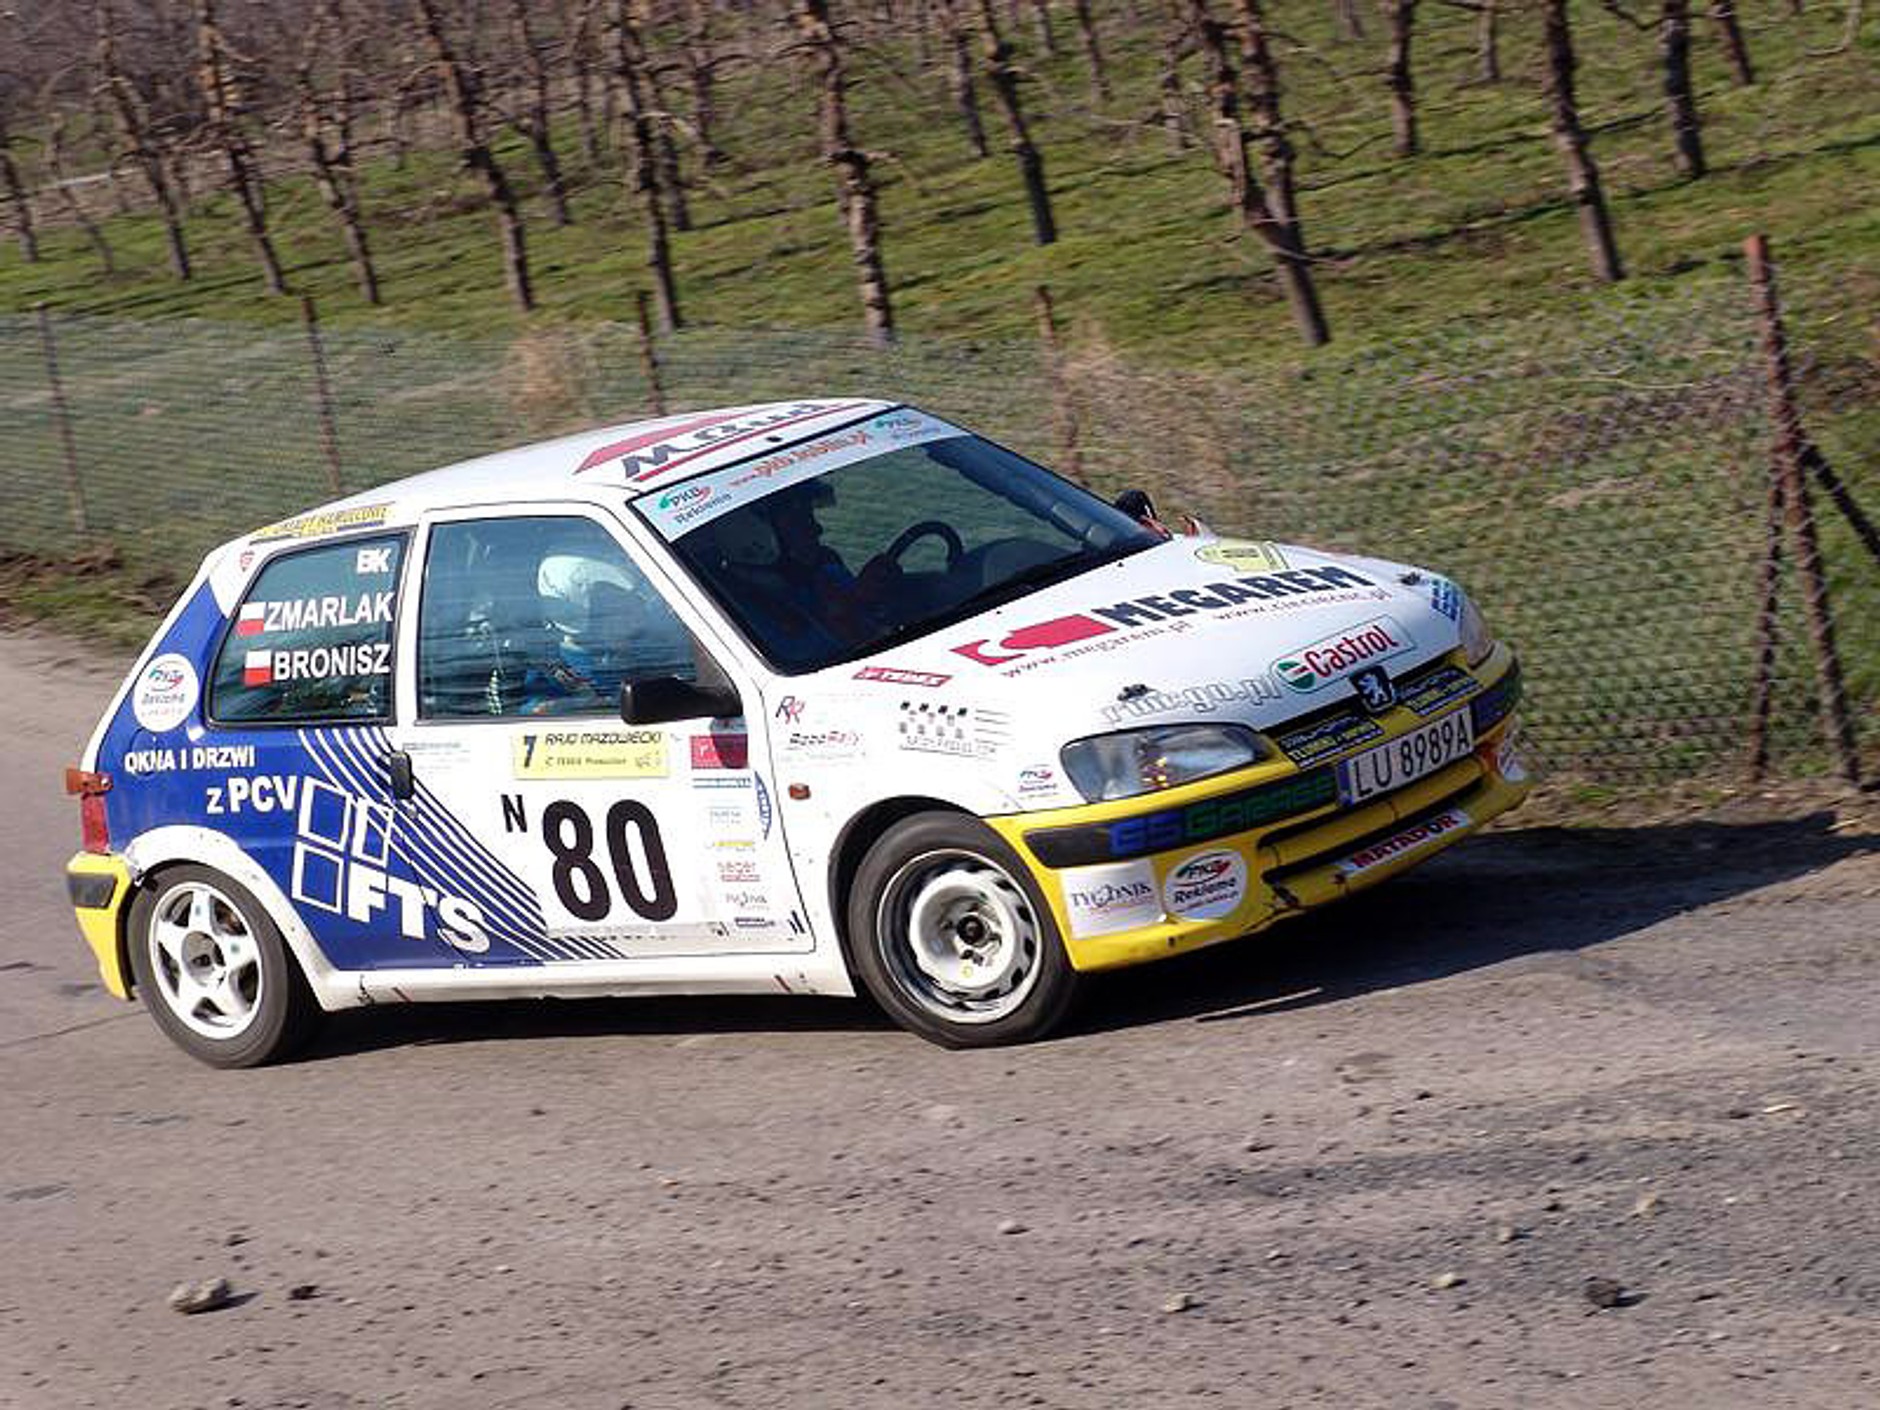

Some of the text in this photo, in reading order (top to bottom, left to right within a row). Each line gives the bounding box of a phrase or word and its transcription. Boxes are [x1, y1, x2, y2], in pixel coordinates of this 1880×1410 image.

[357, 549, 391, 573] BK
[264, 592, 395, 631] ZMARLAK
[1091, 565, 1377, 628] MEGAREM
[274, 644, 390, 680] BRONISZ
[1304, 623, 1399, 679] Castrol
[180, 749, 188, 770] I
[193, 745, 255, 770] DRZWI
[1354, 746, 1393, 798] LU
[1400, 713, 1470, 777] 8989A
[206, 775, 297, 814] z PCV
[501, 794, 528, 833] N
[542, 799, 678, 922] 80
[1353, 814, 1460, 868] MATADOR
[347, 860, 491, 954] FTS
